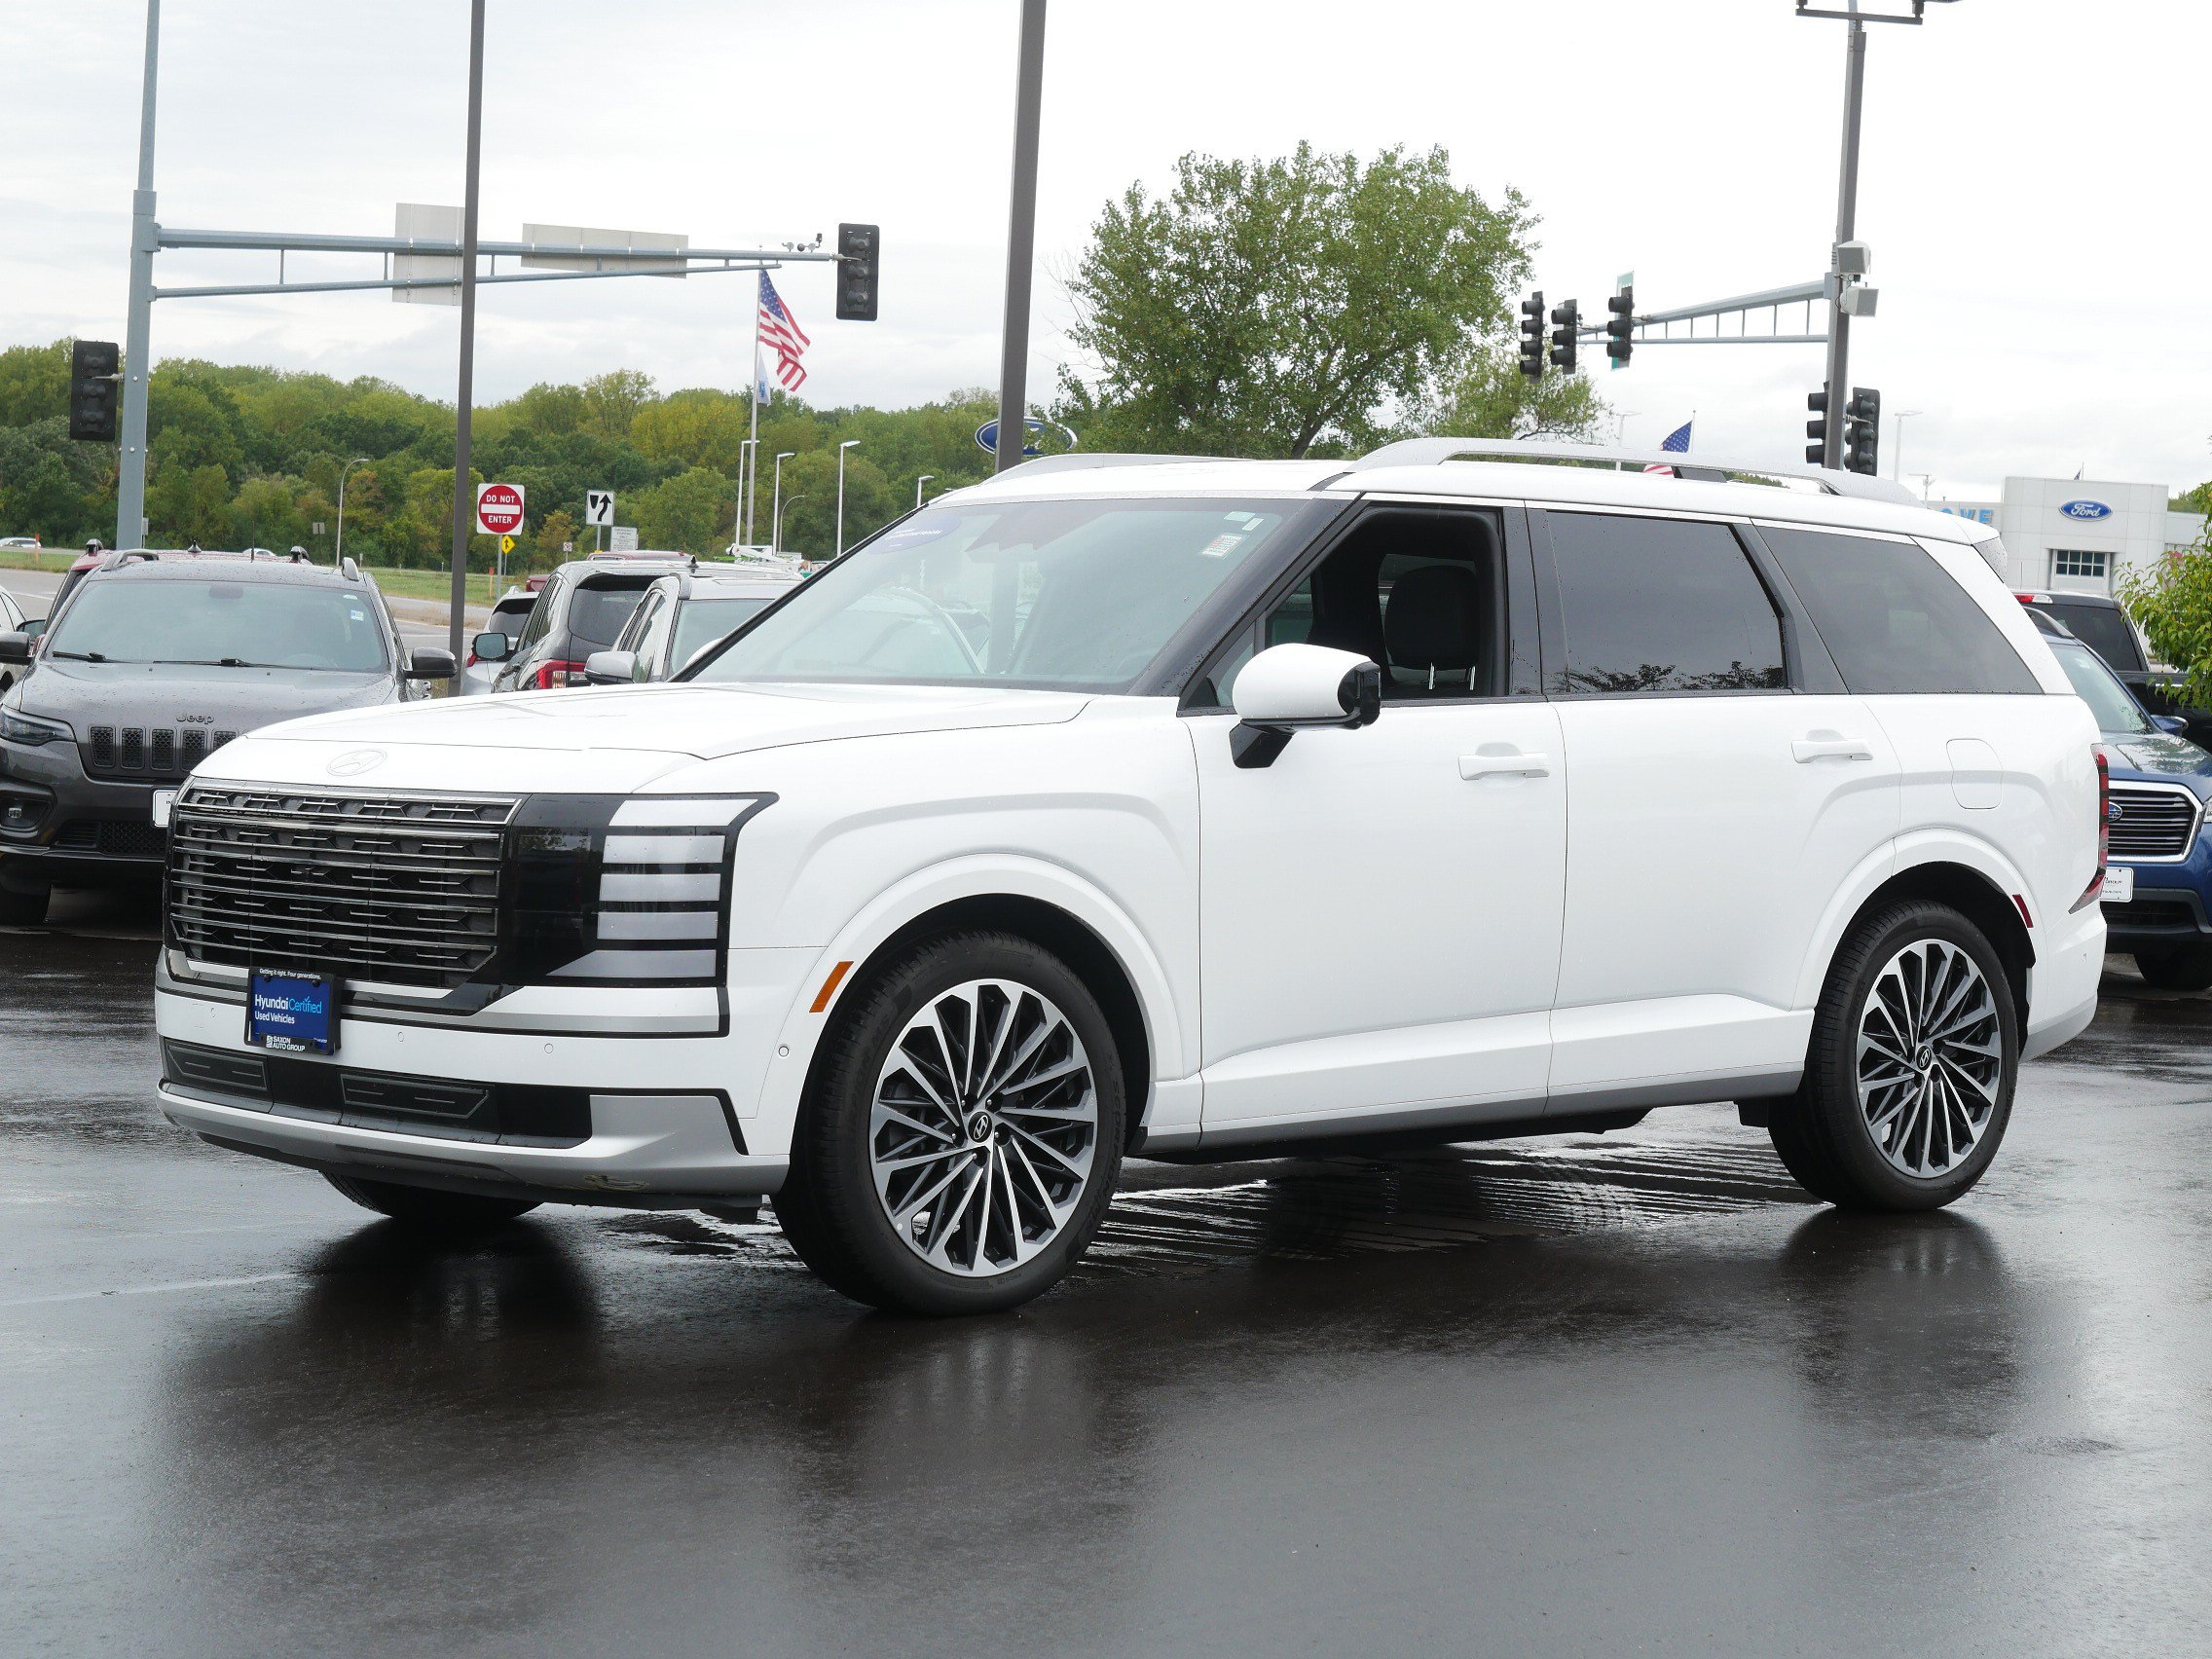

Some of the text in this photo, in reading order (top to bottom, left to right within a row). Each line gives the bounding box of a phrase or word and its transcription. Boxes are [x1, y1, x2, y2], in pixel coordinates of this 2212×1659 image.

[2071, 503, 2101, 517] Ford
[488, 515, 512, 524] ENTER
[176, 712, 214, 724] Jeep
[254, 994, 322, 1014] Hyundai Certified
[254, 1011, 295, 1024] Used Vehicles
[273, 1042, 286, 1051] AUTO
